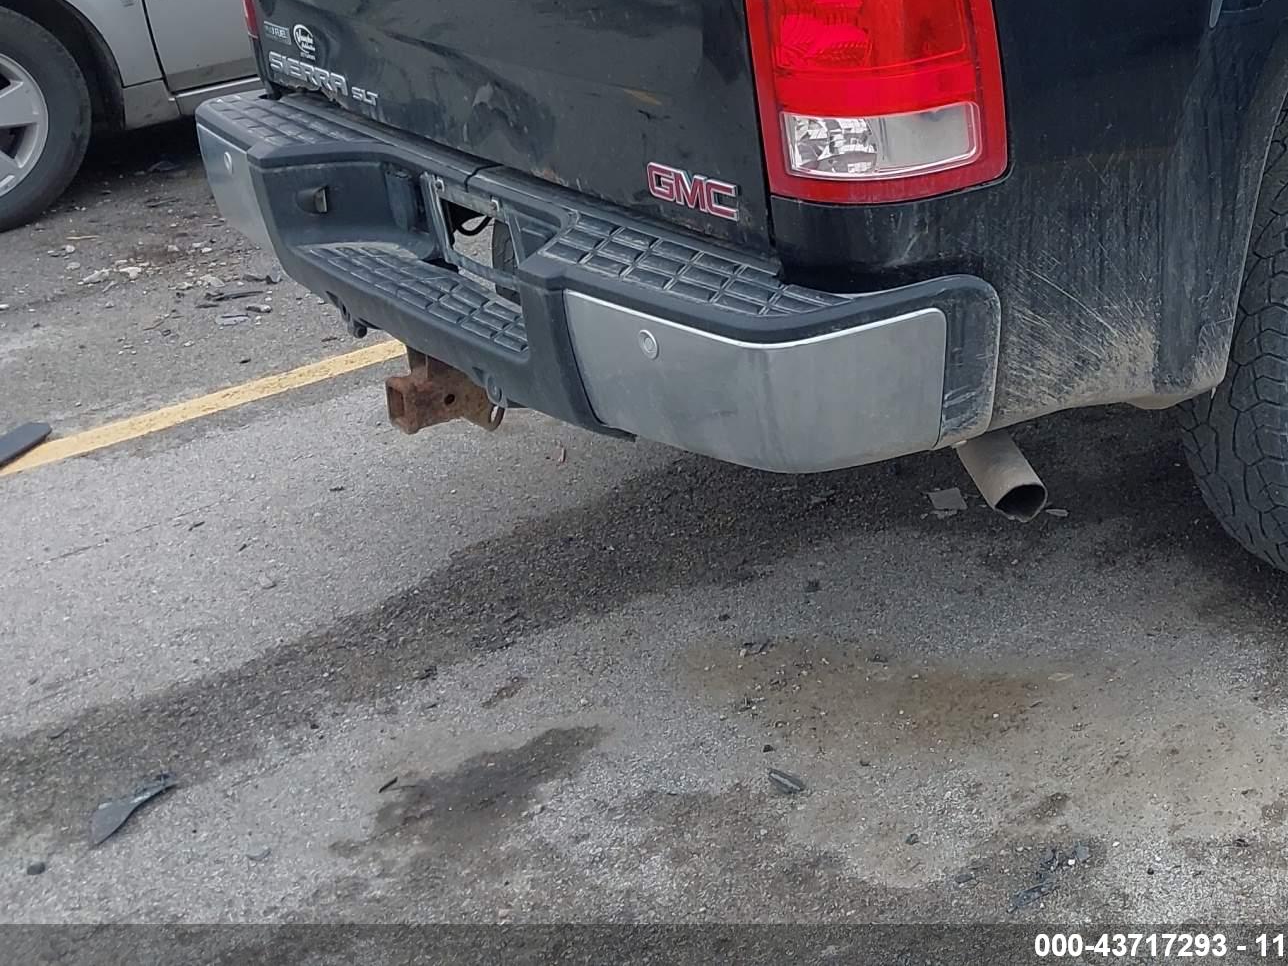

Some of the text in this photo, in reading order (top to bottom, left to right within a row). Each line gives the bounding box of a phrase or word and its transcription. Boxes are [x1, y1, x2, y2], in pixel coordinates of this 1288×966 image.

[268, 50, 379, 107] SIERRA SLT
[646, 161, 740, 222] GMC
